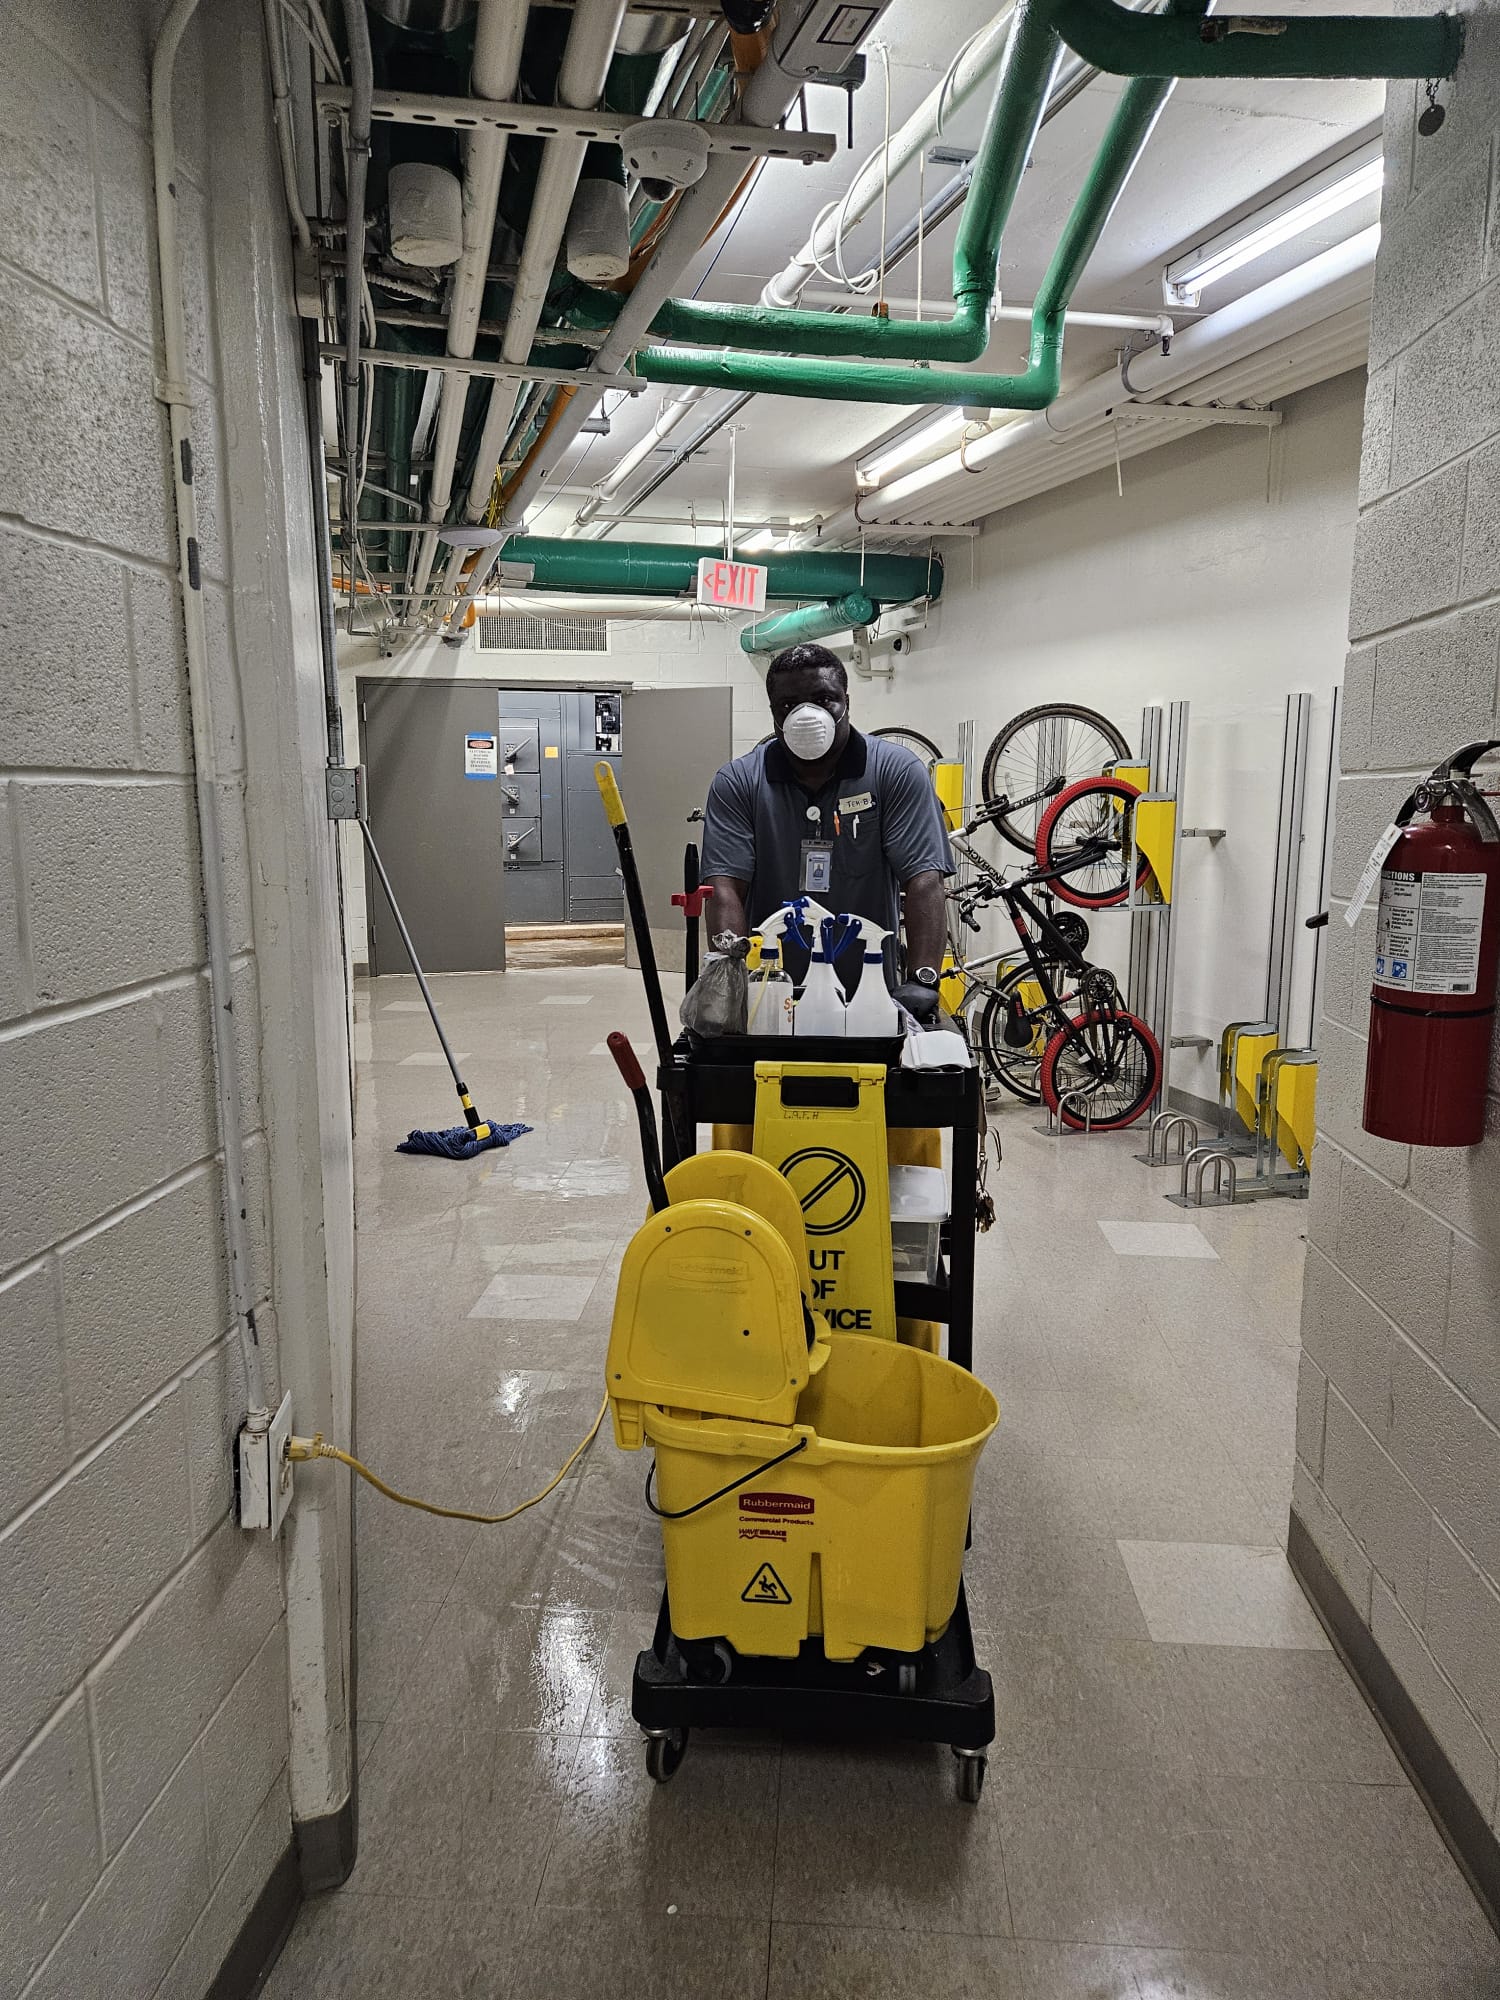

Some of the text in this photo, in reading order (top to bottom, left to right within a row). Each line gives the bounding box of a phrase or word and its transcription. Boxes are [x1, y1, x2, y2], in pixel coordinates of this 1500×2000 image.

[714, 563, 759, 606] EXIT
[809, 1249, 846, 1271] UT
[743, 1498, 811, 1510] Rubbermaid
[783, 1518, 814, 1526] Products
